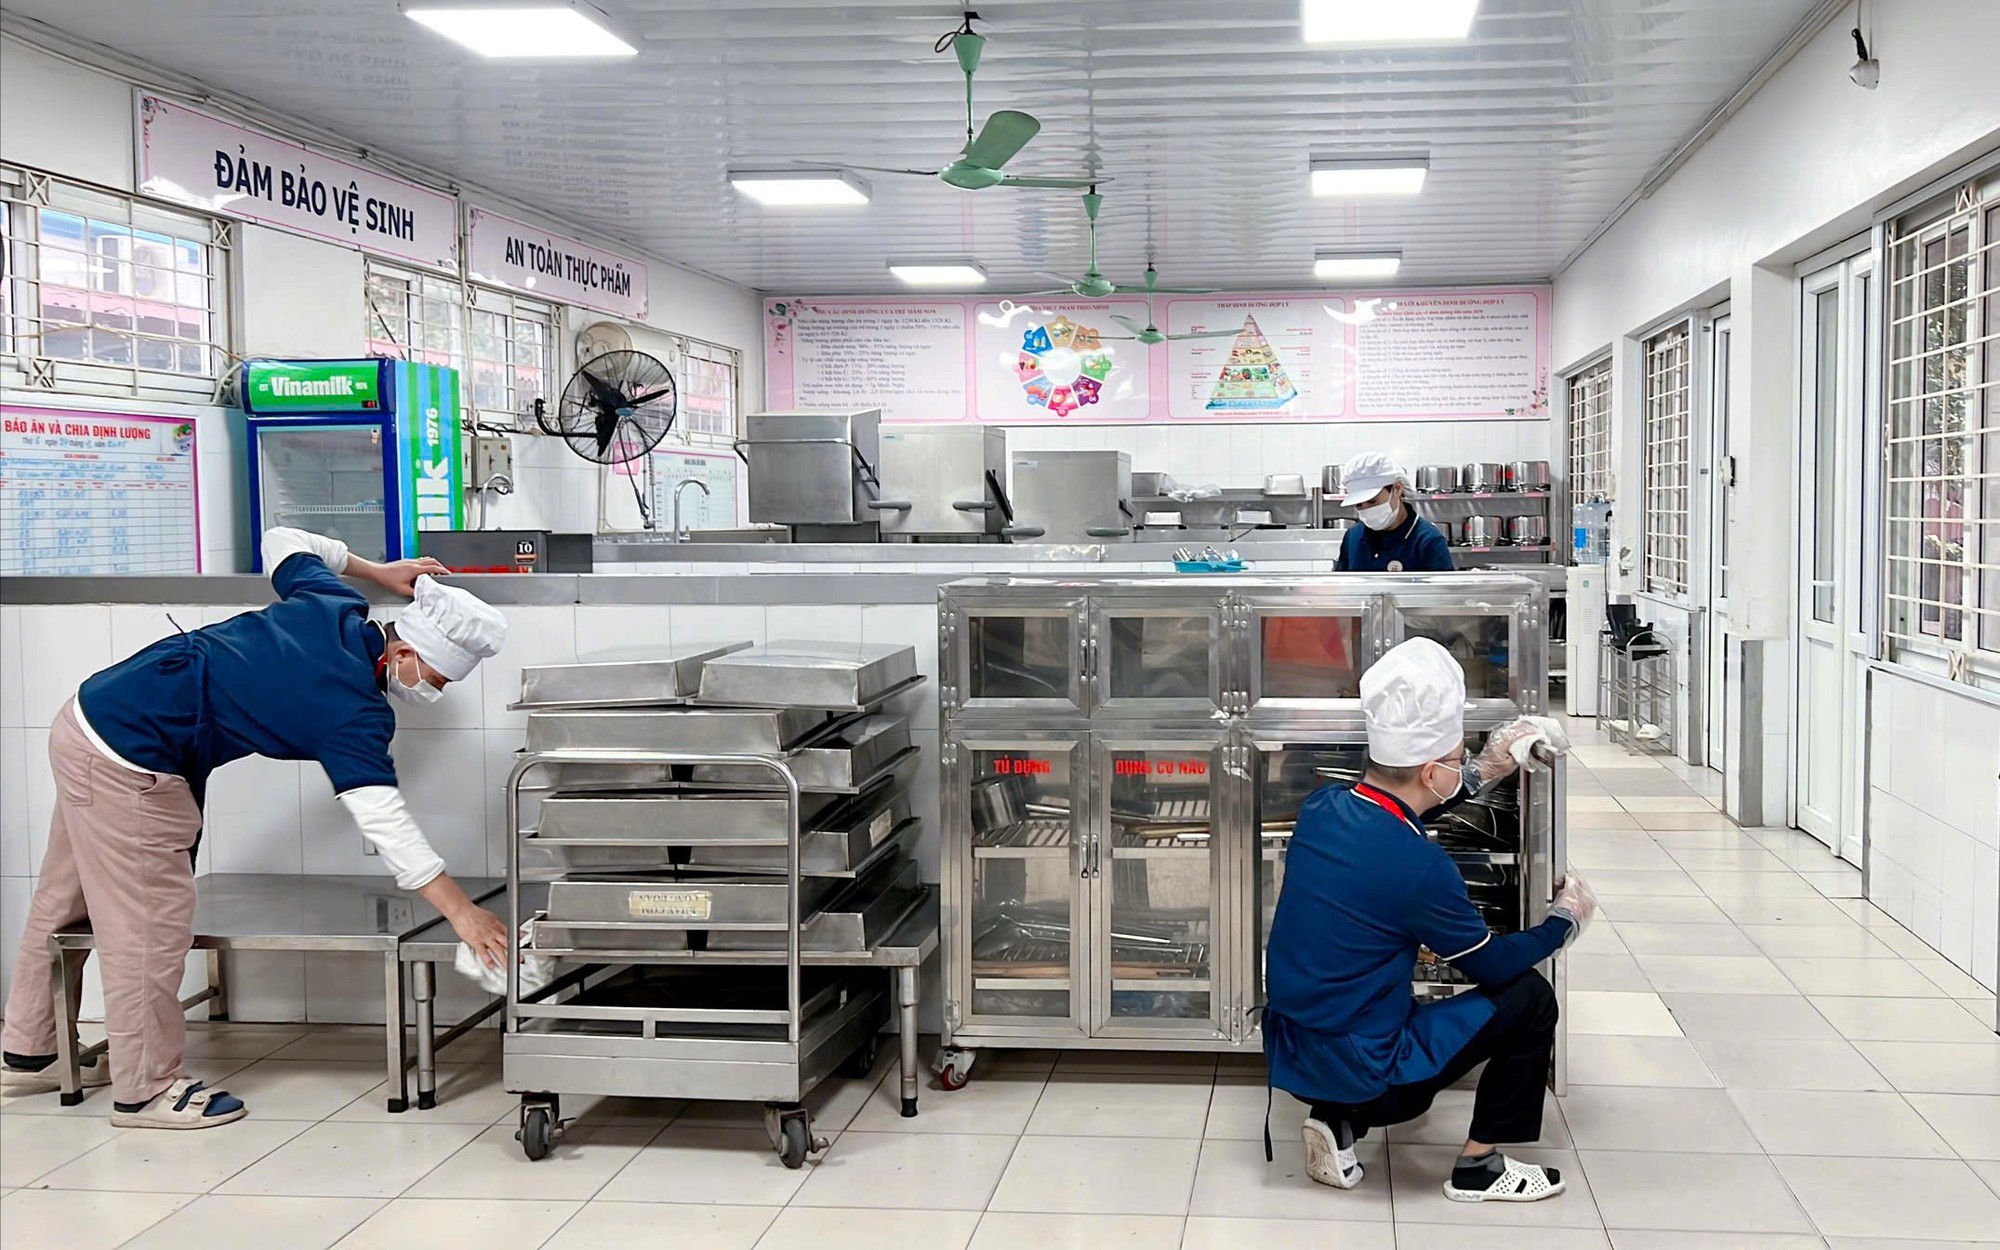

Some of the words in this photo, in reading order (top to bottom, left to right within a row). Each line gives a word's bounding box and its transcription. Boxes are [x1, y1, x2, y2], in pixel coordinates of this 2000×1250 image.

[214, 144, 273, 202] ĐẢM
[281, 164, 327, 217] BẢO
[332, 180, 360, 234] VỆ
[366, 198, 414, 242] SINH
[506, 236, 525, 268] AN
[528, 239, 563, 279] TOÀN
[565, 254, 598, 292] THỰC
[601, 262, 631, 298] PHẨM
[271, 376, 354, 397] Vinamilk
[31, 419, 45, 434] ĂN
[48, 419, 62, 435] VÀ
[65, 423, 90, 437] CHIA
[92, 425, 118, 439] ĐỊNH
[426, 407, 440, 447] 1976
[517, 543, 533, 554] 10
